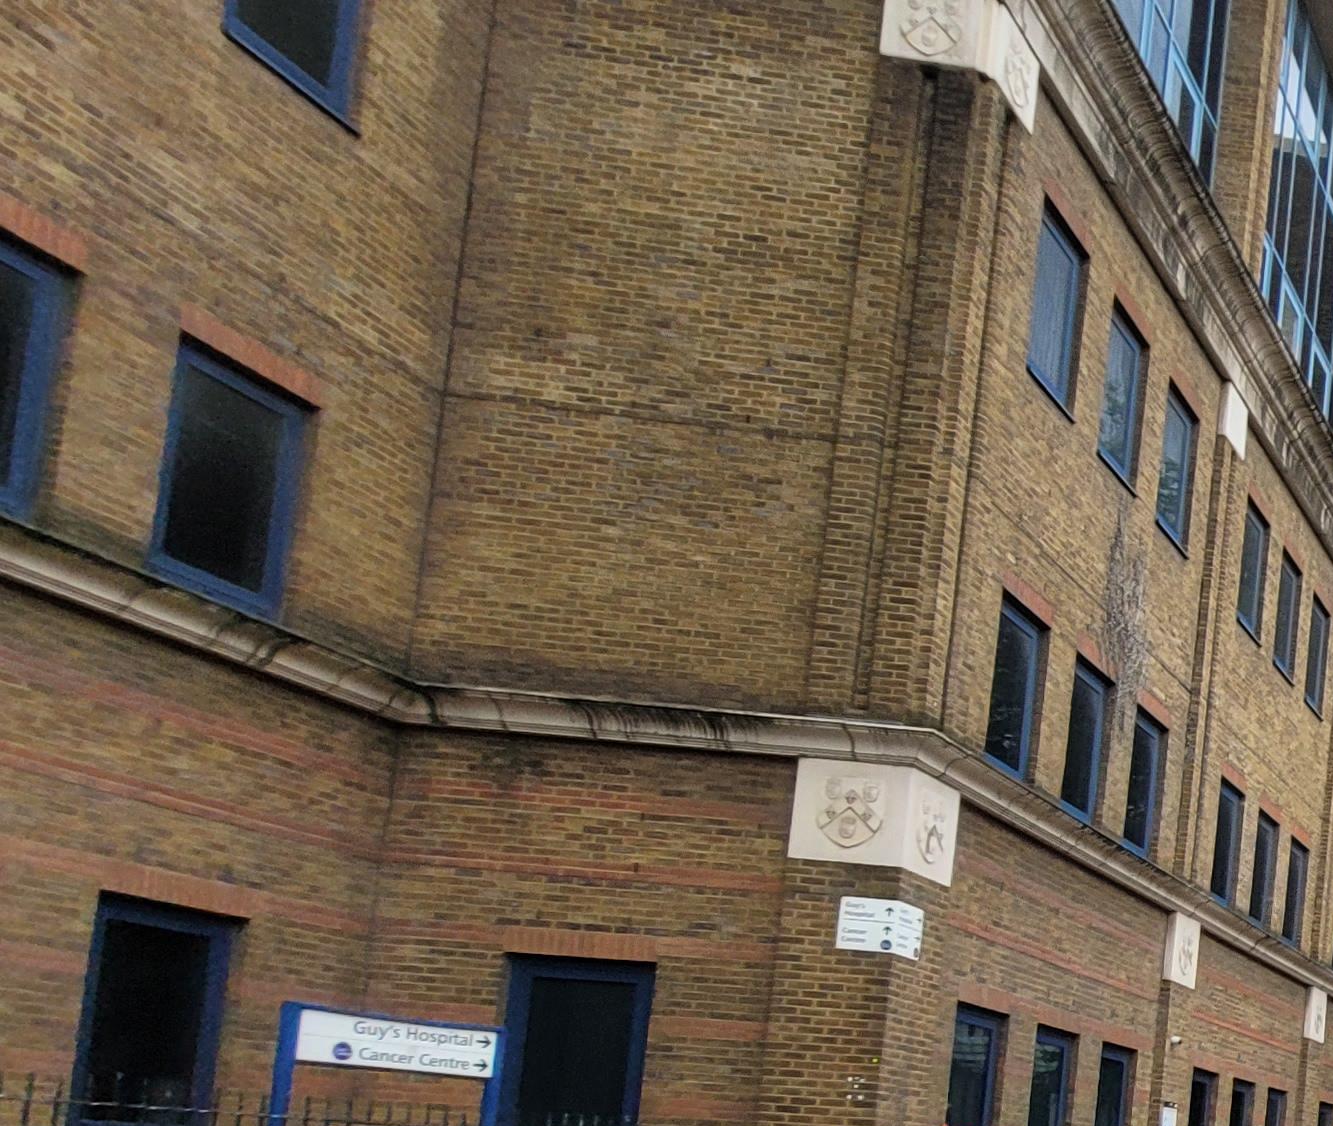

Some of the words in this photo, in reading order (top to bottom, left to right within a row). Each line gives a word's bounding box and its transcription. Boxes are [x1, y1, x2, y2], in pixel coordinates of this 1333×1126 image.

[353, 1020, 401, 1040] Guy's
[405, 1027, 473, 1047] Hospital
[358, 1047, 415, 1065] Cancer
[418, 1053, 470, 1071] Centre
